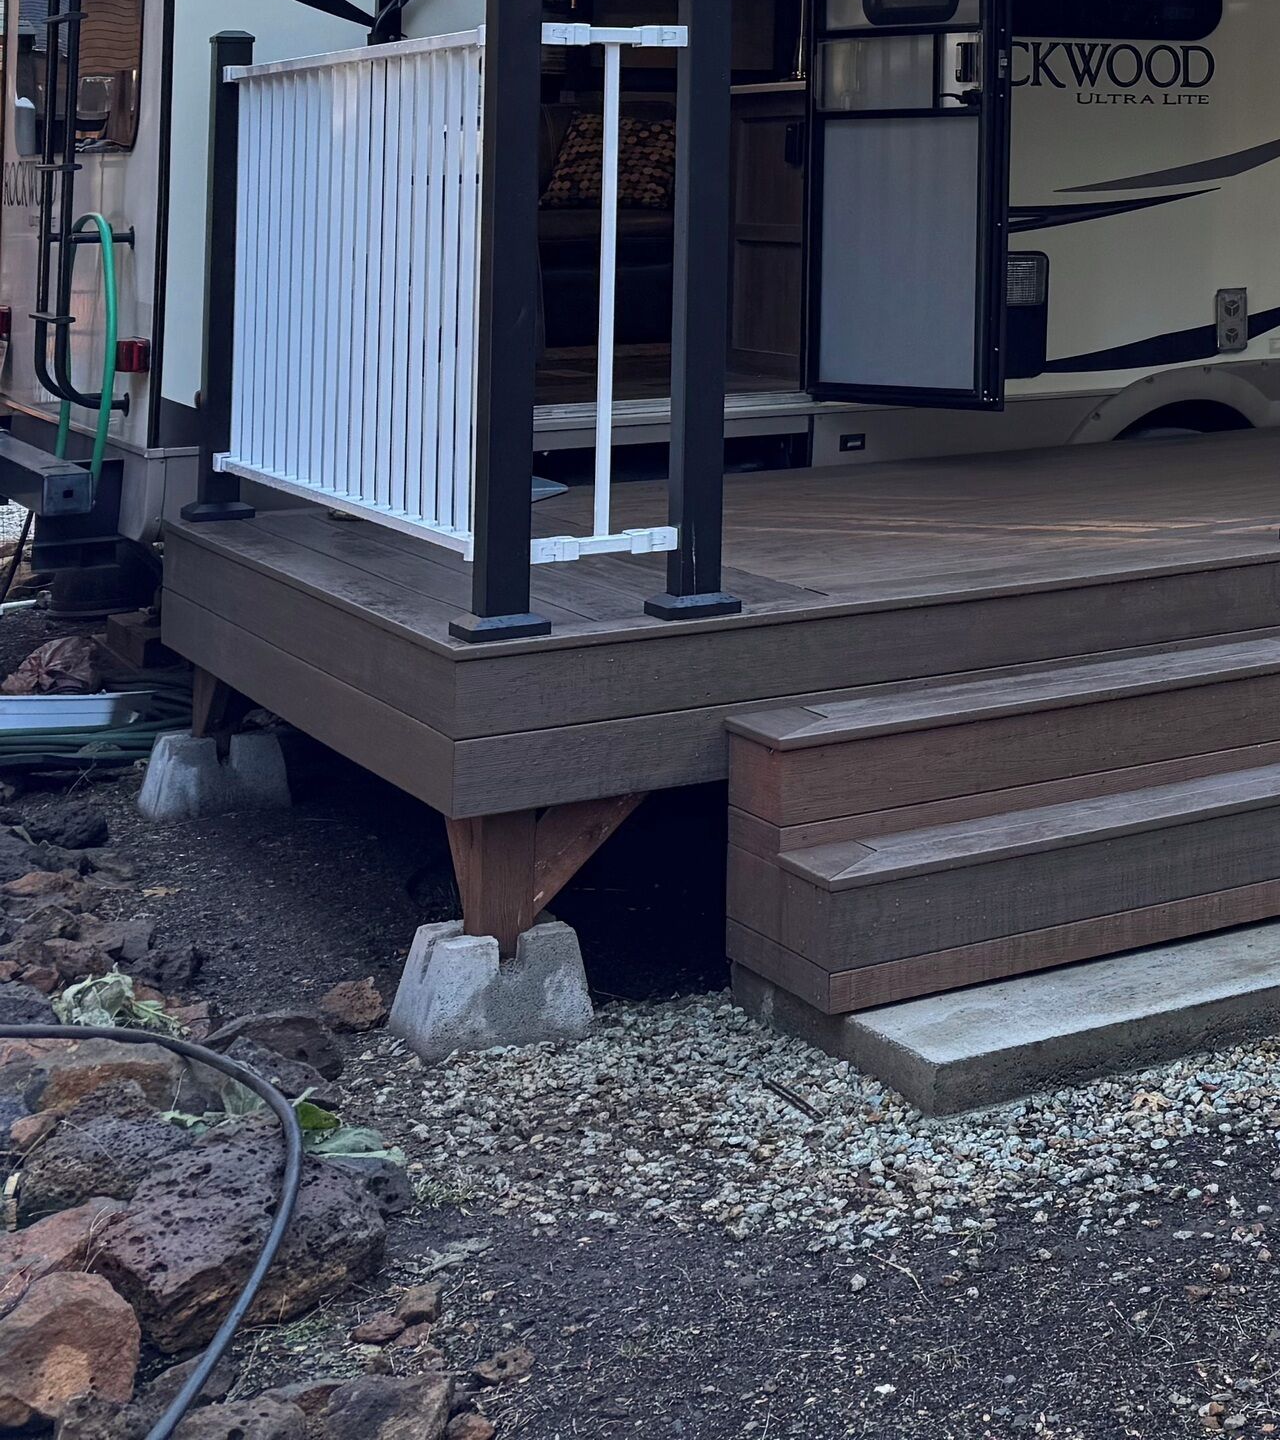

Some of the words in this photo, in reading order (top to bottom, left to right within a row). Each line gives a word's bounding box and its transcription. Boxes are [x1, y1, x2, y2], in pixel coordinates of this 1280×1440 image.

[1012, 41, 1215, 88] CKWOOD
[1076, 92, 1154, 105] ULTRA
[1162, 93, 1210, 105] LITE
[4, 161, 57, 207] ROCKWO
